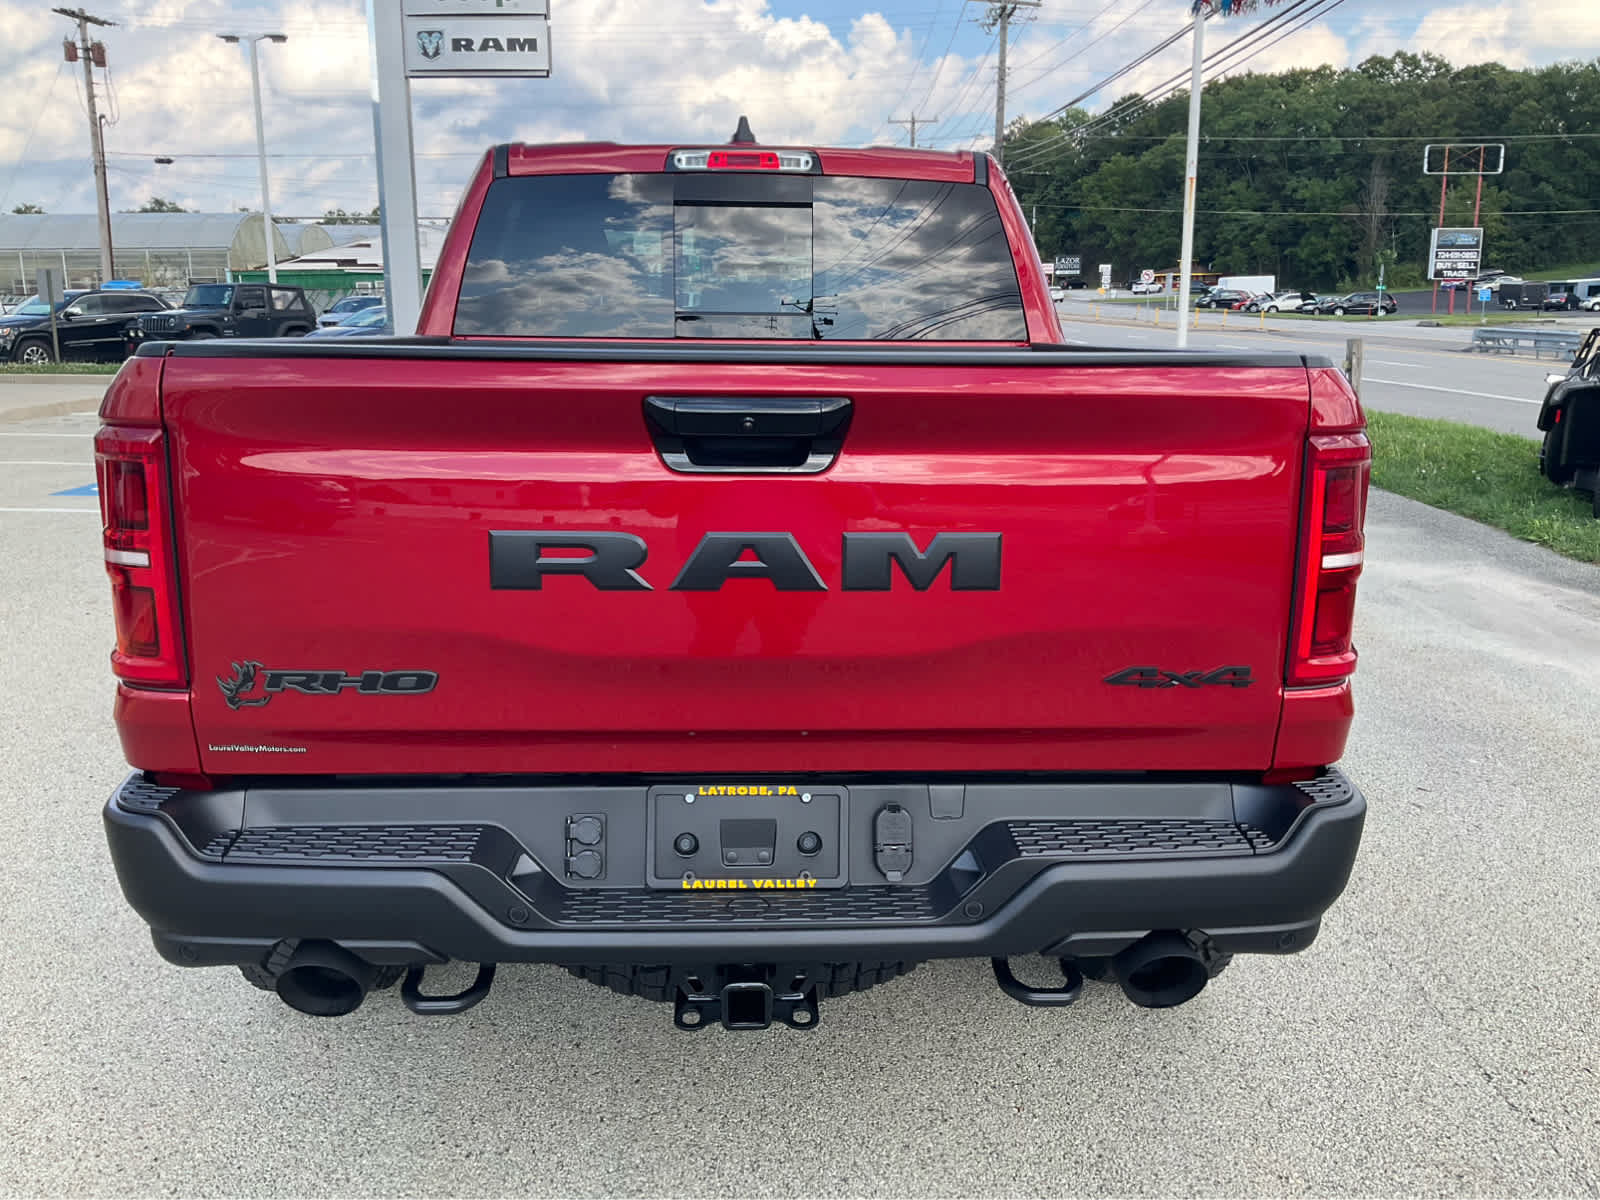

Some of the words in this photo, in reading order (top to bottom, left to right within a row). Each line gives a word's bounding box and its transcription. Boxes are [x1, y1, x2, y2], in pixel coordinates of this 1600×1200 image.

[451, 37, 538, 52] RAM
[488, 529, 1004, 592] RAM
[260, 670, 439, 694] RHO
[208, 743, 307, 754] LaurelValleyMotors.com
[698, 785, 773, 796] LATROBE,
[778, 785, 798, 795] PA
[682, 879, 748, 889] LAUREL
[752, 879, 817, 889] VALLEY
